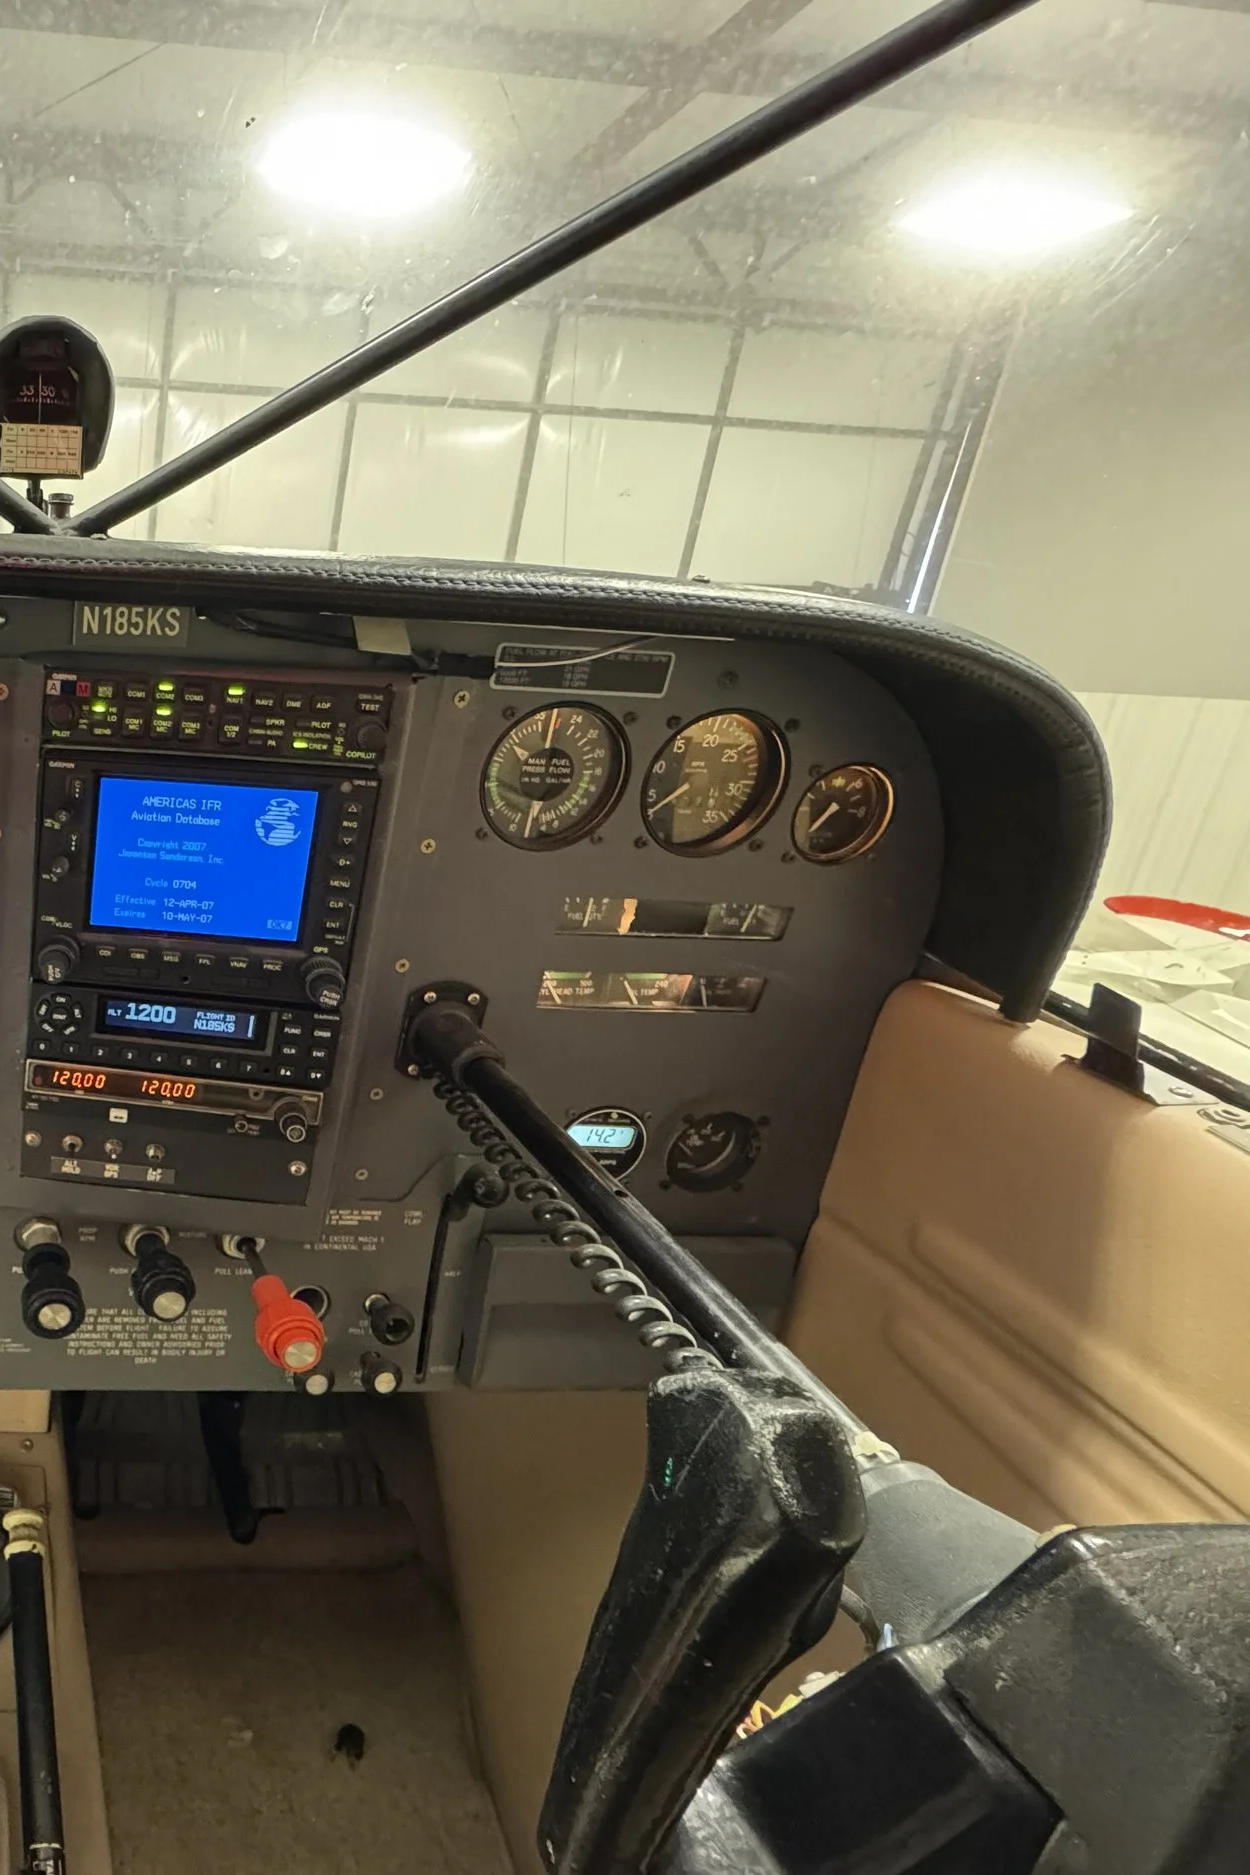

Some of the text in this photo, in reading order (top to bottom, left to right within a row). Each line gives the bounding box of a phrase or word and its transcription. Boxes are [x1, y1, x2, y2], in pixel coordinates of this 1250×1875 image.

[19, 385, 55, 397] 33 30
[82, 606, 181, 637] N185KS
[361, 703, 380, 711] TEST
[311, 721, 331, 729] PILOT
[571, 715, 582, 723] 24
[587, 729, 599, 738] 22
[673, 738, 685, 753] 15
[702, 734, 719, 747] 20
[346, 751, 376, 759] COPILOT
[721, 750, 738, 762] 25
[652, 760, 666, 773] 10
[647, 789, 656, 801] 5
[725, 783, 743, 796] 30
[142, 796, 222, 811] AMERICAS IFR
[131, 810, 220, 826] Aviation Database
[702, 811, 718, 823] 35
[137, 838, 179, 850] Copyright
[145, 877, 197, 890] Cycle 0704
[330, 880, 350, 888] MENU
[115, 894, 214, 910] Effective 12-APR-07
[114, 908, 213, 924] Expires 10-MAY-07
[107, 1002, 176, 1024] ALT 1200
[197, 1011, 222, 1021] FLIGHT
[194, 1019, 236, 1033] N185KS
[284, 1027, 302, 1035] FUNC
[283, 1047, 296, 1055] CLR
[53, 1070, 106, 1089] 120.00
[141, 1080, 195, 1099] 120.00
[586, 1128, 616, 1144] 14.2
[215, 1267, 232, 1275] PULL
[102, 1308, 118, 1316] THAT
[114, 1316, 146, 1324] REMOVED
[126, 1324, 149, 1332] FLIGHT
[134, 1356, 157, 1364] DEATH
